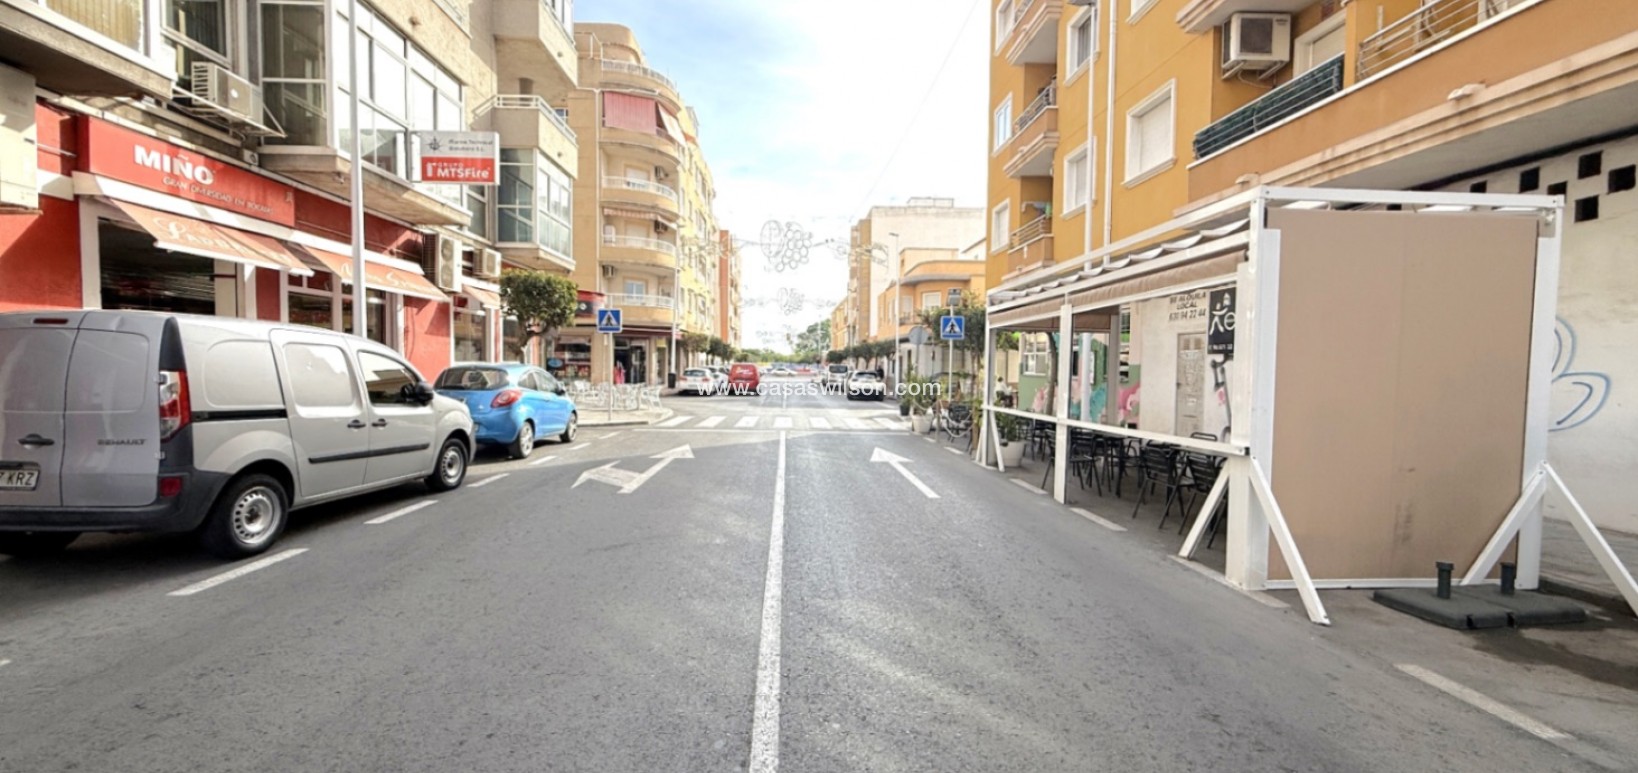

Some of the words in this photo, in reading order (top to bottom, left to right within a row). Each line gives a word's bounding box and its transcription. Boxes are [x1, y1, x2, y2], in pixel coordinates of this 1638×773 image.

[134, 144, 214, 185] MIÑO
[437, 167, 489, 178] MTSFire
[163, 176, 188, 190] GRAN
[1179, 291, 1206, 302] ALQUILA
[1176, 302, 1197, 310] LOCAL
[6, 472, 35, 486] KRZ
